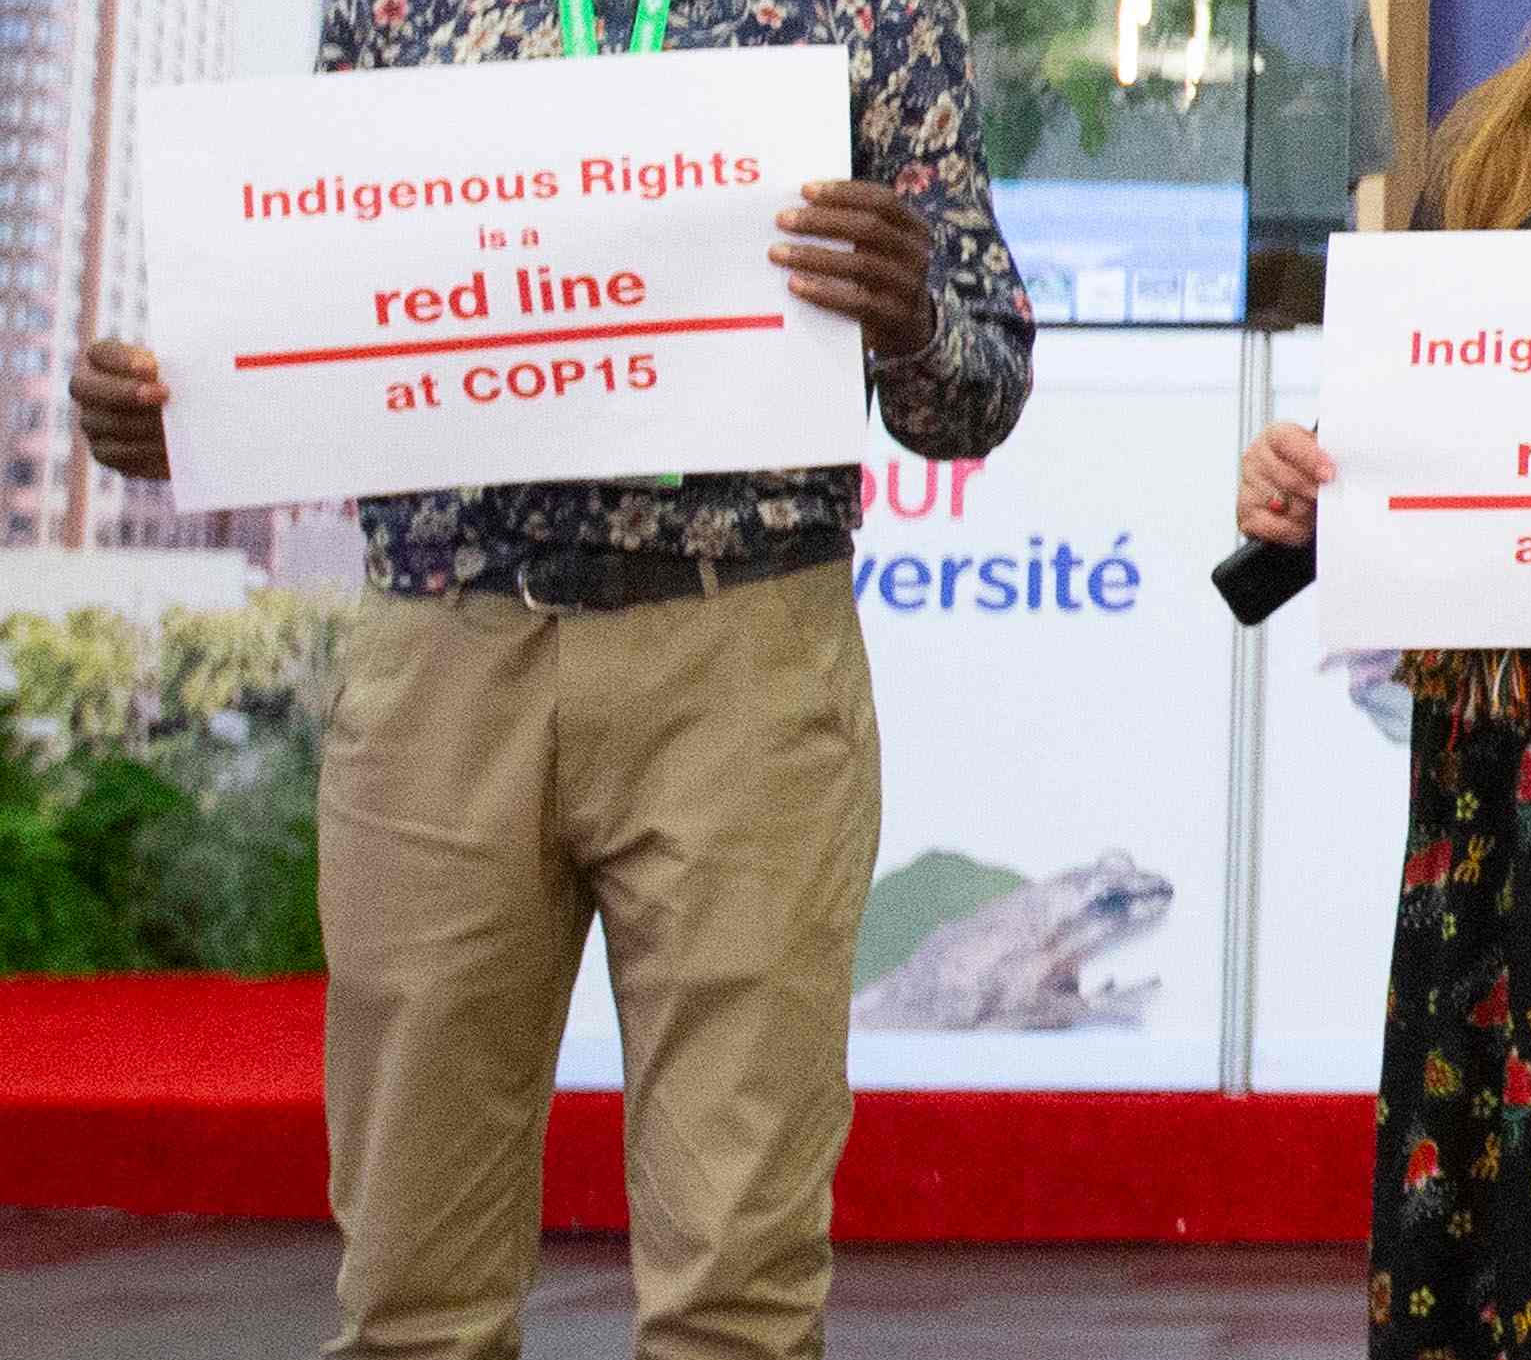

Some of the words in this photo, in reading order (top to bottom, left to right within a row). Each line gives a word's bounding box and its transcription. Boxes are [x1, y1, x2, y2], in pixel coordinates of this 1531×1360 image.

[242, 170, 560, 222] Indigenous
[579, 151, 761, 201] Rights
[477, 224, 508, 251] is
[520, 227, 542, 249] a
[373, 270, 490, 328] red
[515, 265, 647, 316] line
[385, 372, 440, 413] at
[462, 353, 657, 406] COP15
